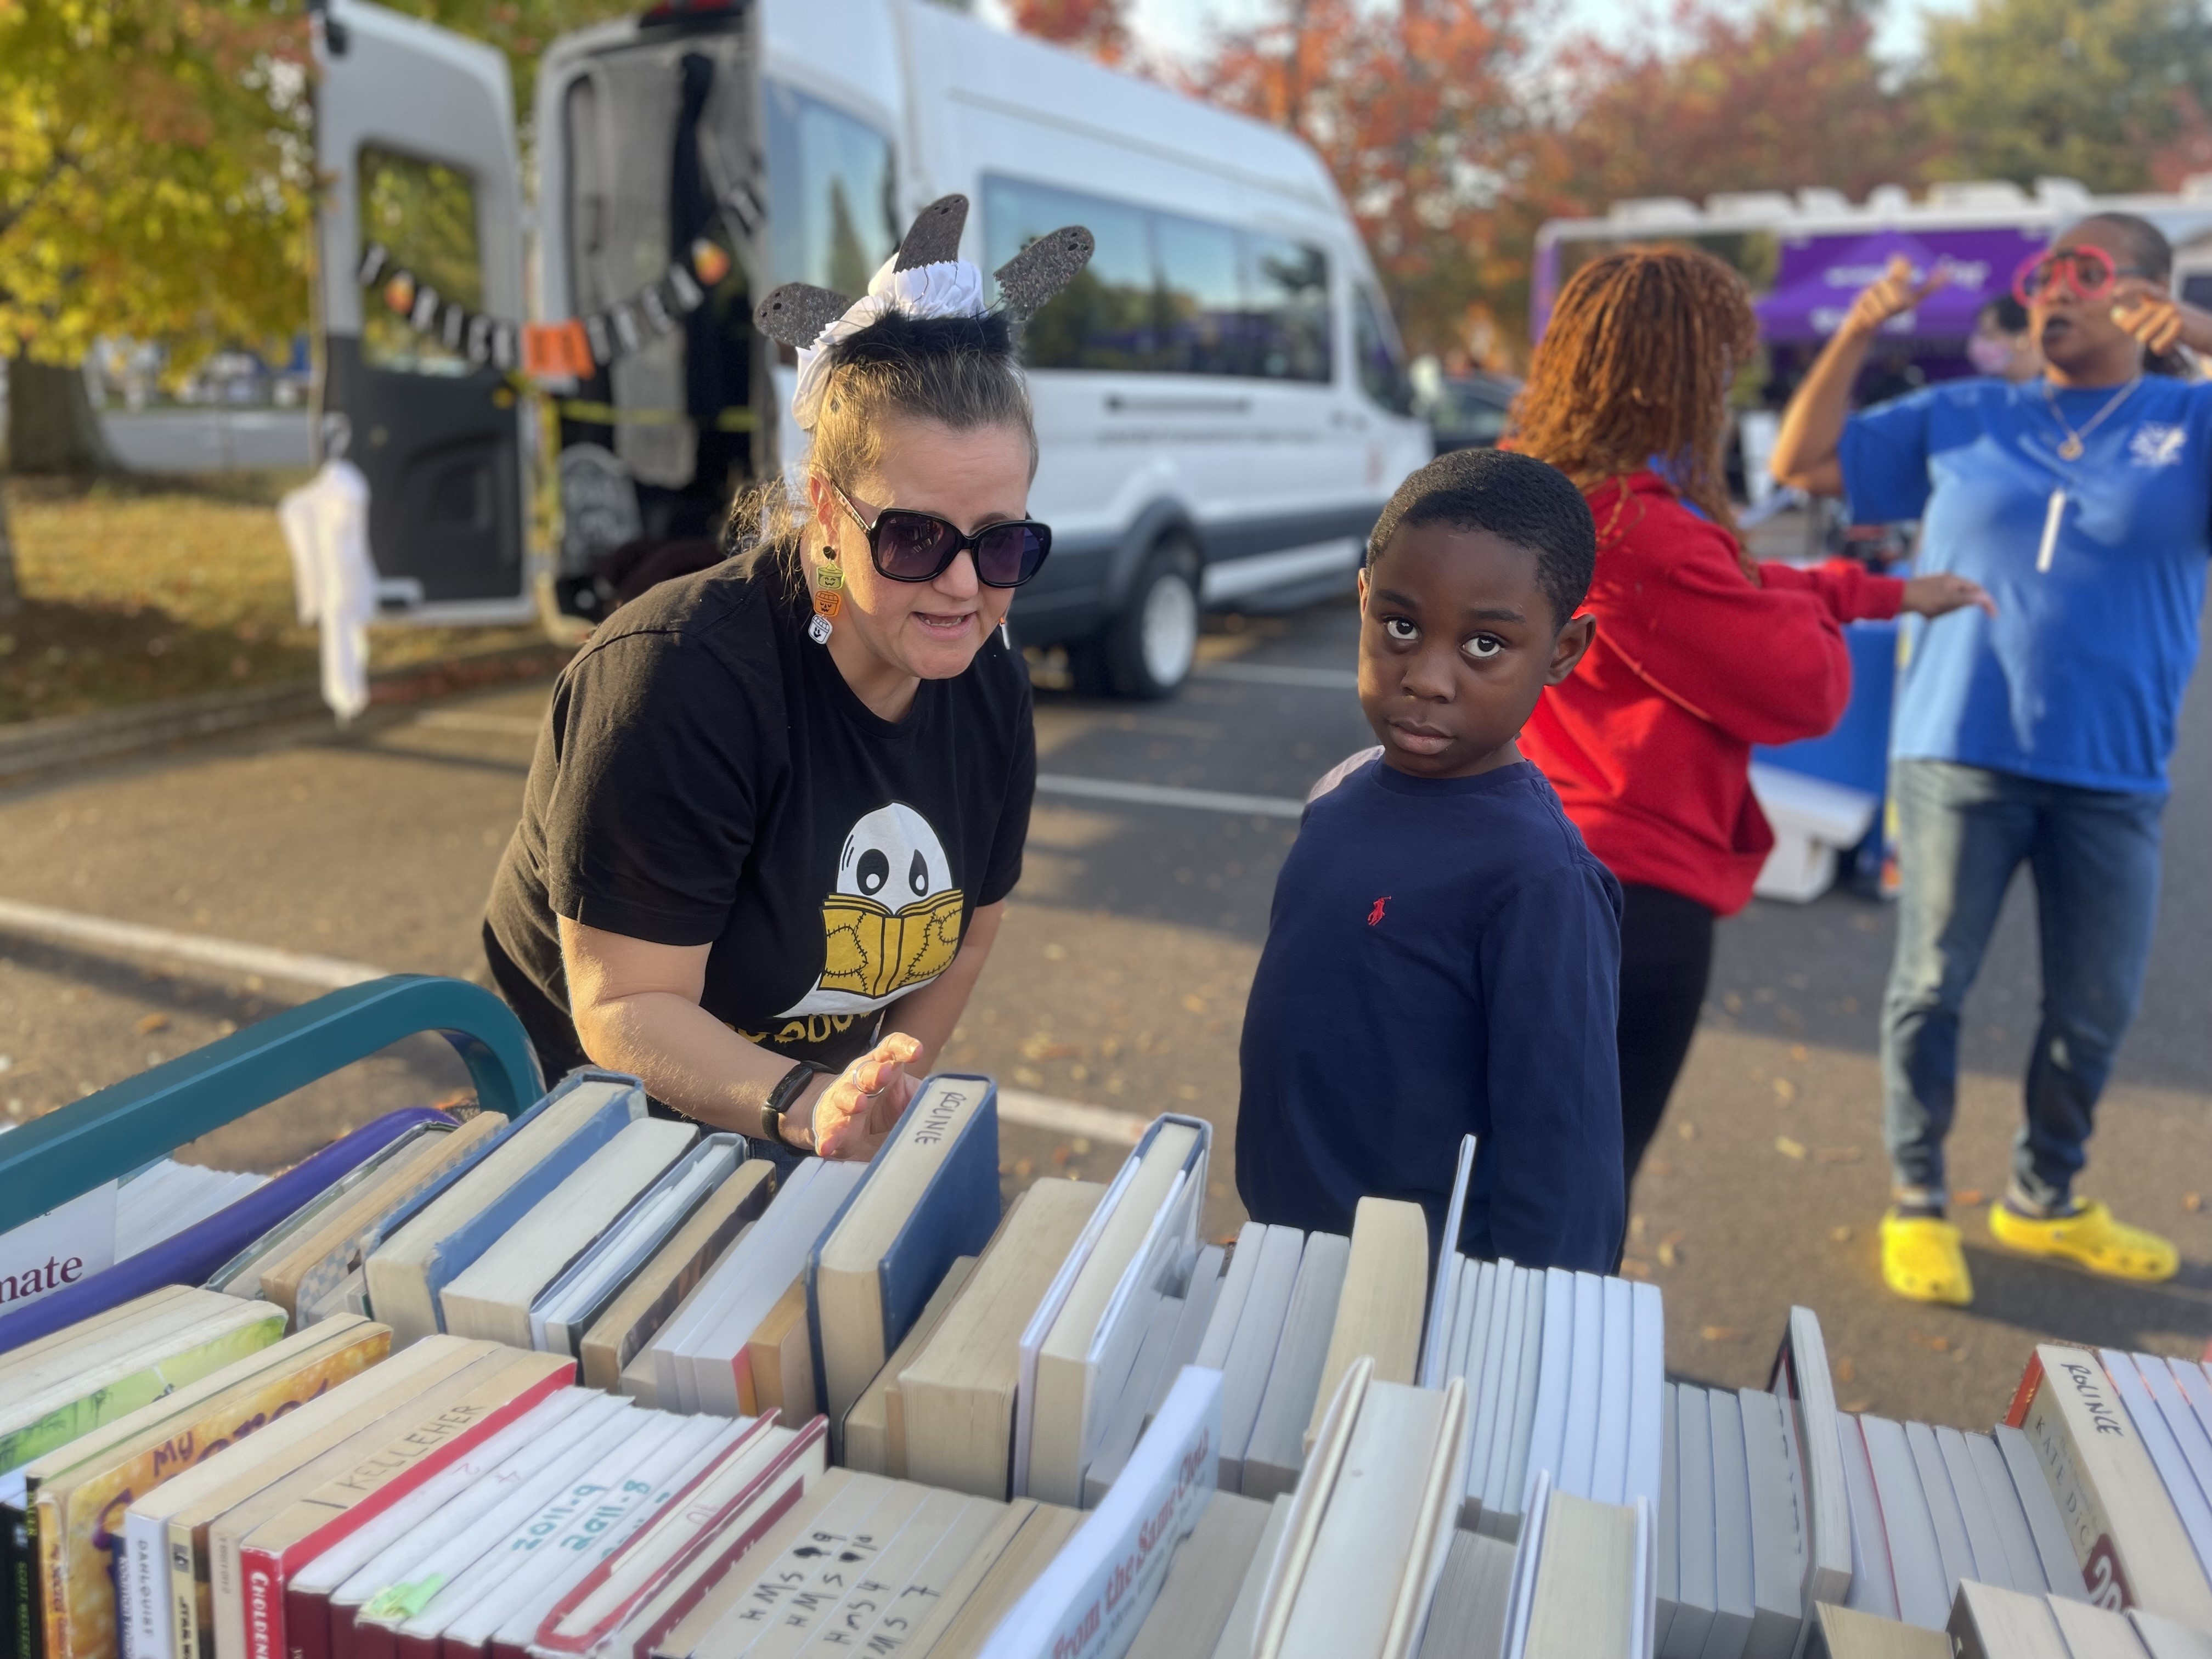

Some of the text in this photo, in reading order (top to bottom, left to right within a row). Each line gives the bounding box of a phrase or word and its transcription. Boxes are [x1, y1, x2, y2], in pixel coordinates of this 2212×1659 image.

[154, 1430, 194, 1477] My
[335, 1405, 487, 1491] KELLEHER
[2035, 1414, 2063, 1486] KATE
[862, 1616, 909, 1659] MS
